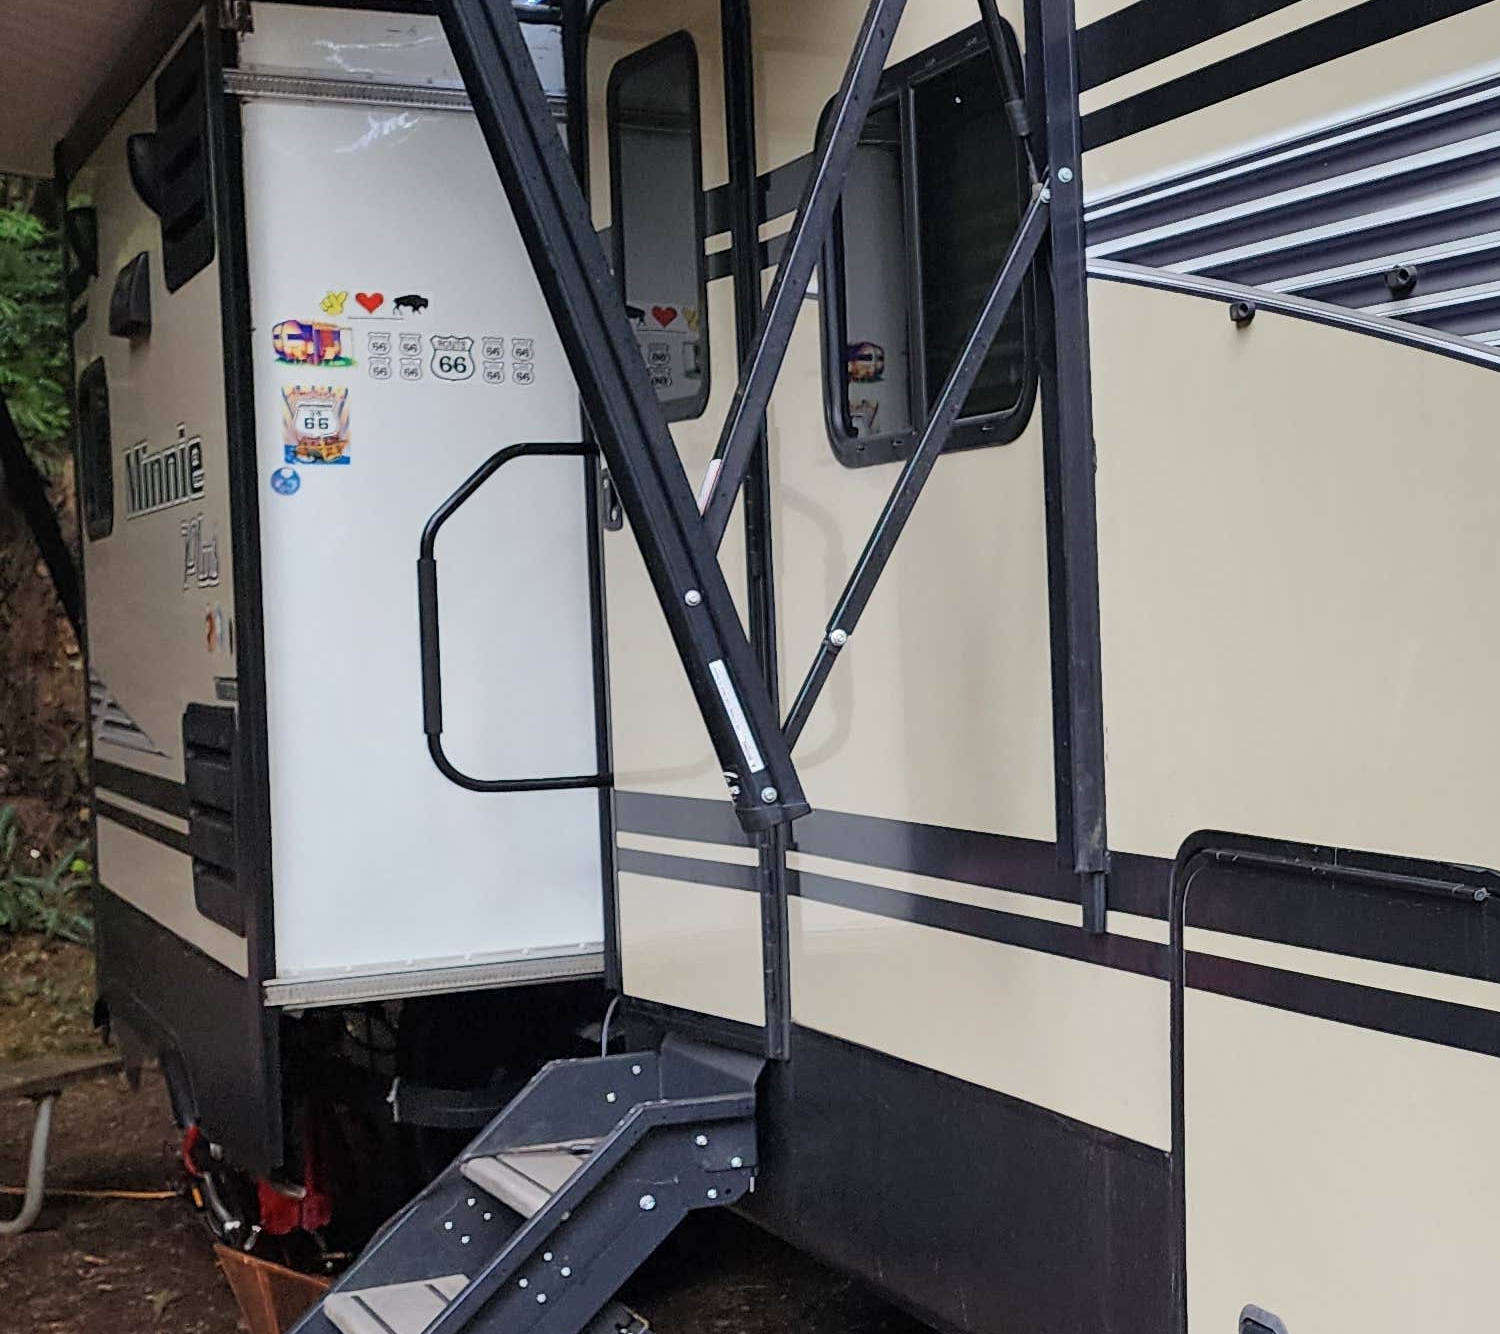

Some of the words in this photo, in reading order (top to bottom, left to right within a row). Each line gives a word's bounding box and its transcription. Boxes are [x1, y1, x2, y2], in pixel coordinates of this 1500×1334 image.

[440, 356, 466, 373] 66
[304, 417, 329, 430] 66
[124, 422, 205, 520] Minnie
